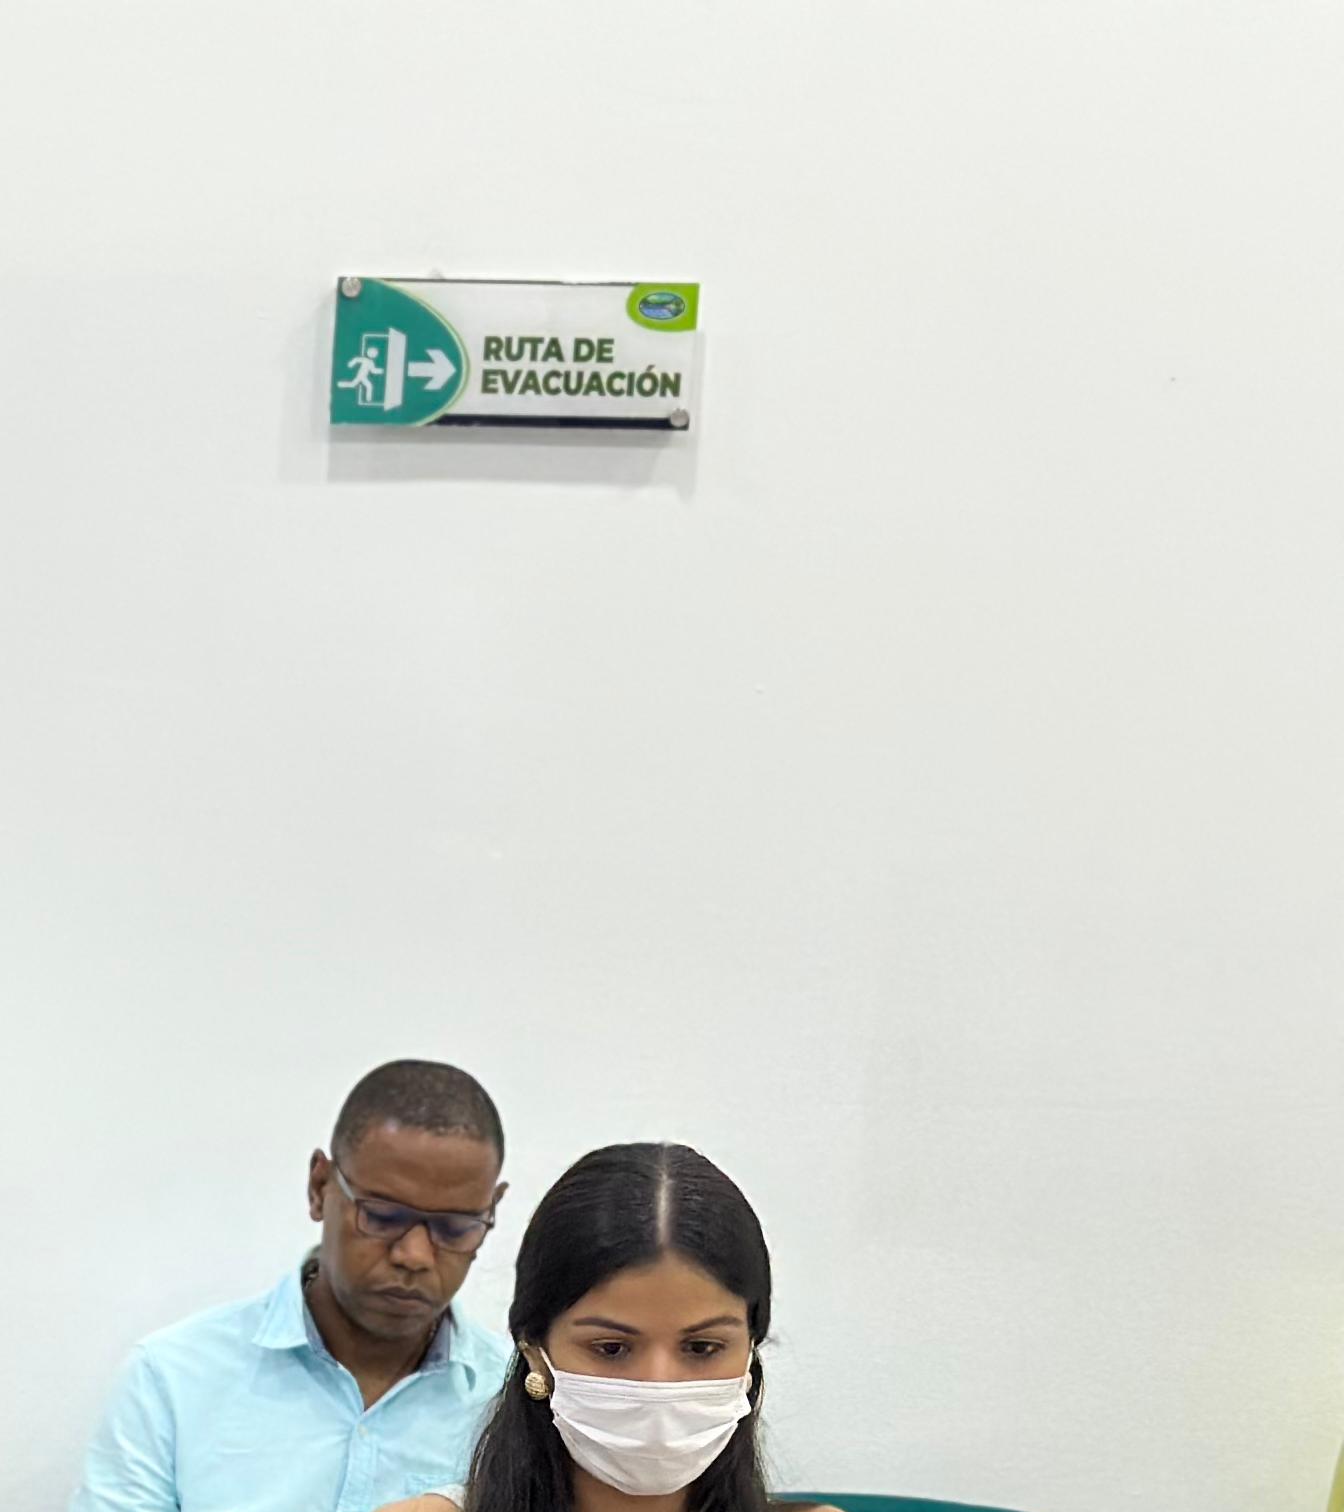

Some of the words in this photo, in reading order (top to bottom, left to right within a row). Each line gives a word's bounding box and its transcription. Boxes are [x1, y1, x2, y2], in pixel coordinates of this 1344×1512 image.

[483, 336, 565, 363] RUTA
[572, 338, 615, 364] DE
[480, 364, 682, 398] EVACUACIÓN
